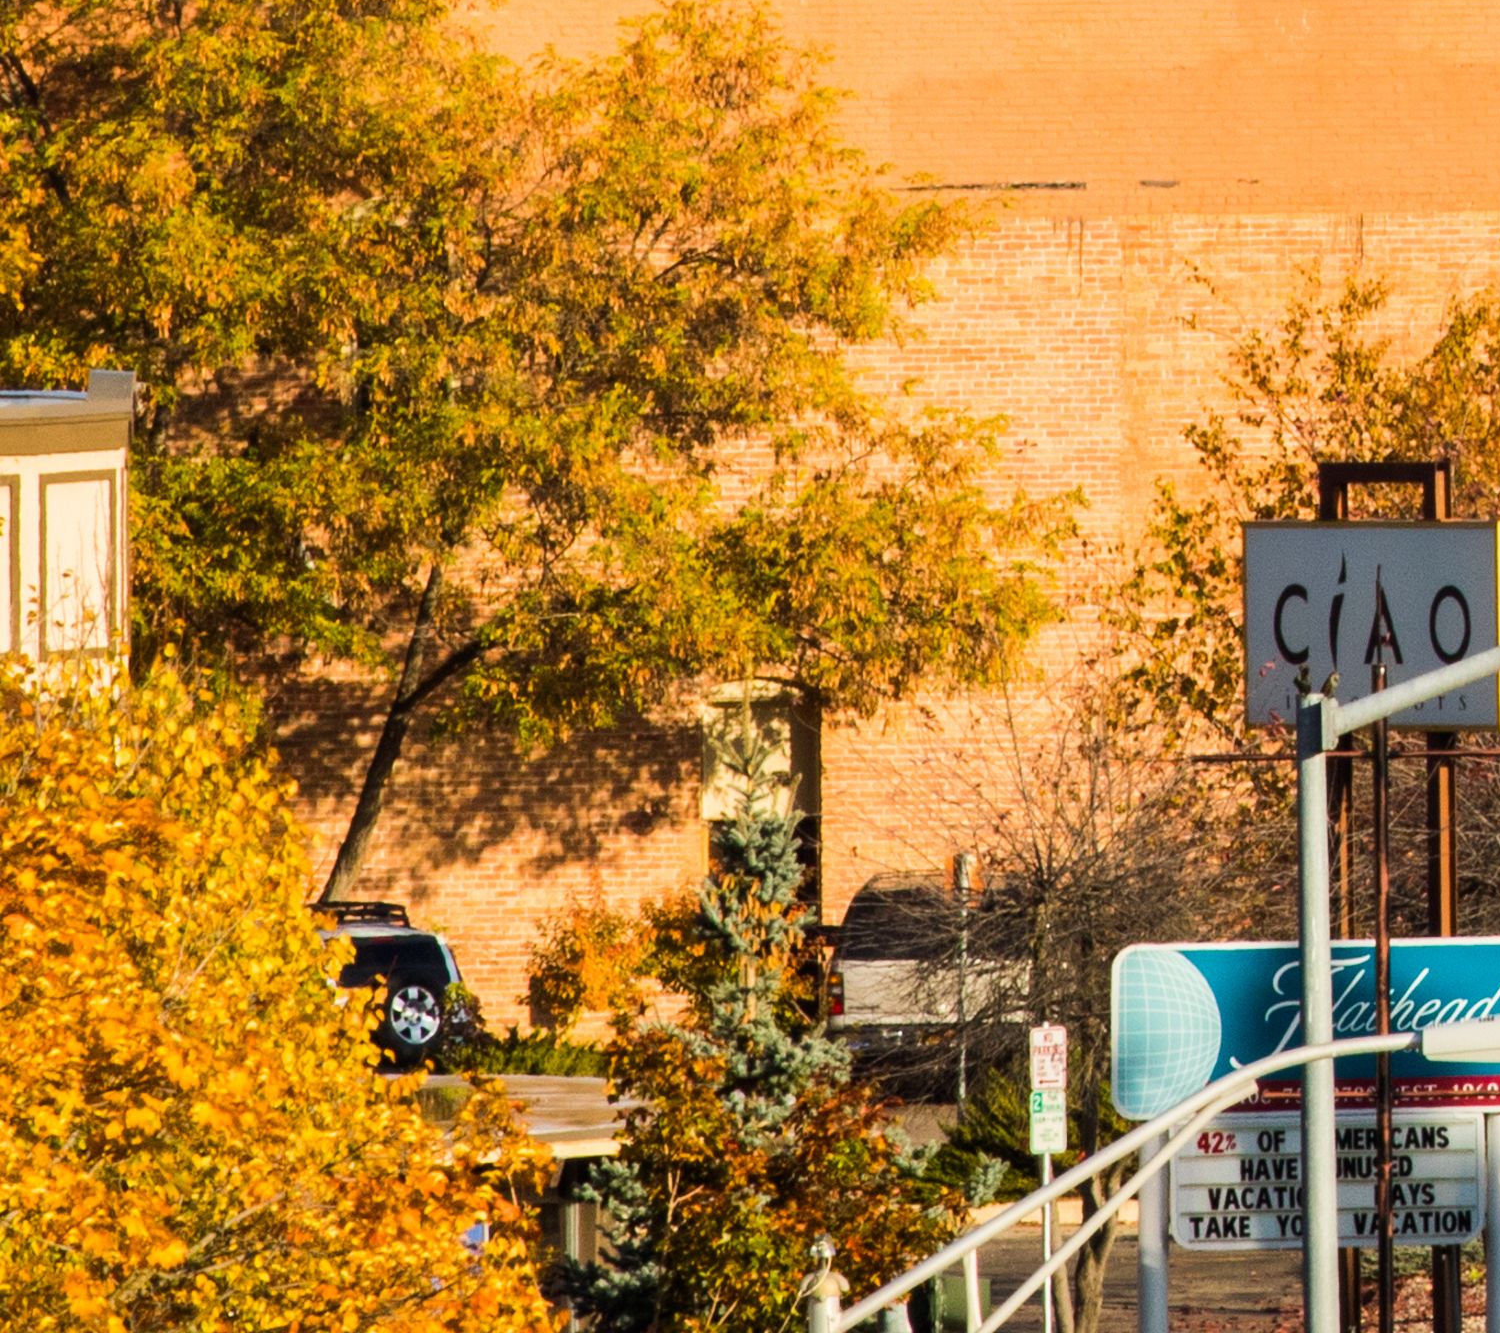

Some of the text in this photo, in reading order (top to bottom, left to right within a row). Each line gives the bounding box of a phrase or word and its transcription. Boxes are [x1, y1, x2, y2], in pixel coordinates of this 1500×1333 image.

[1196, 1126, 1450, 1154] 42% OF MERCANS
[1239, 1158, 1299, 1182] HAVE
[1207, 1186, 1302, 1211] VACATI
[1189, 1216, 1251, 1238] TAKE
[1276, 1215, 1302, 1237] YO
